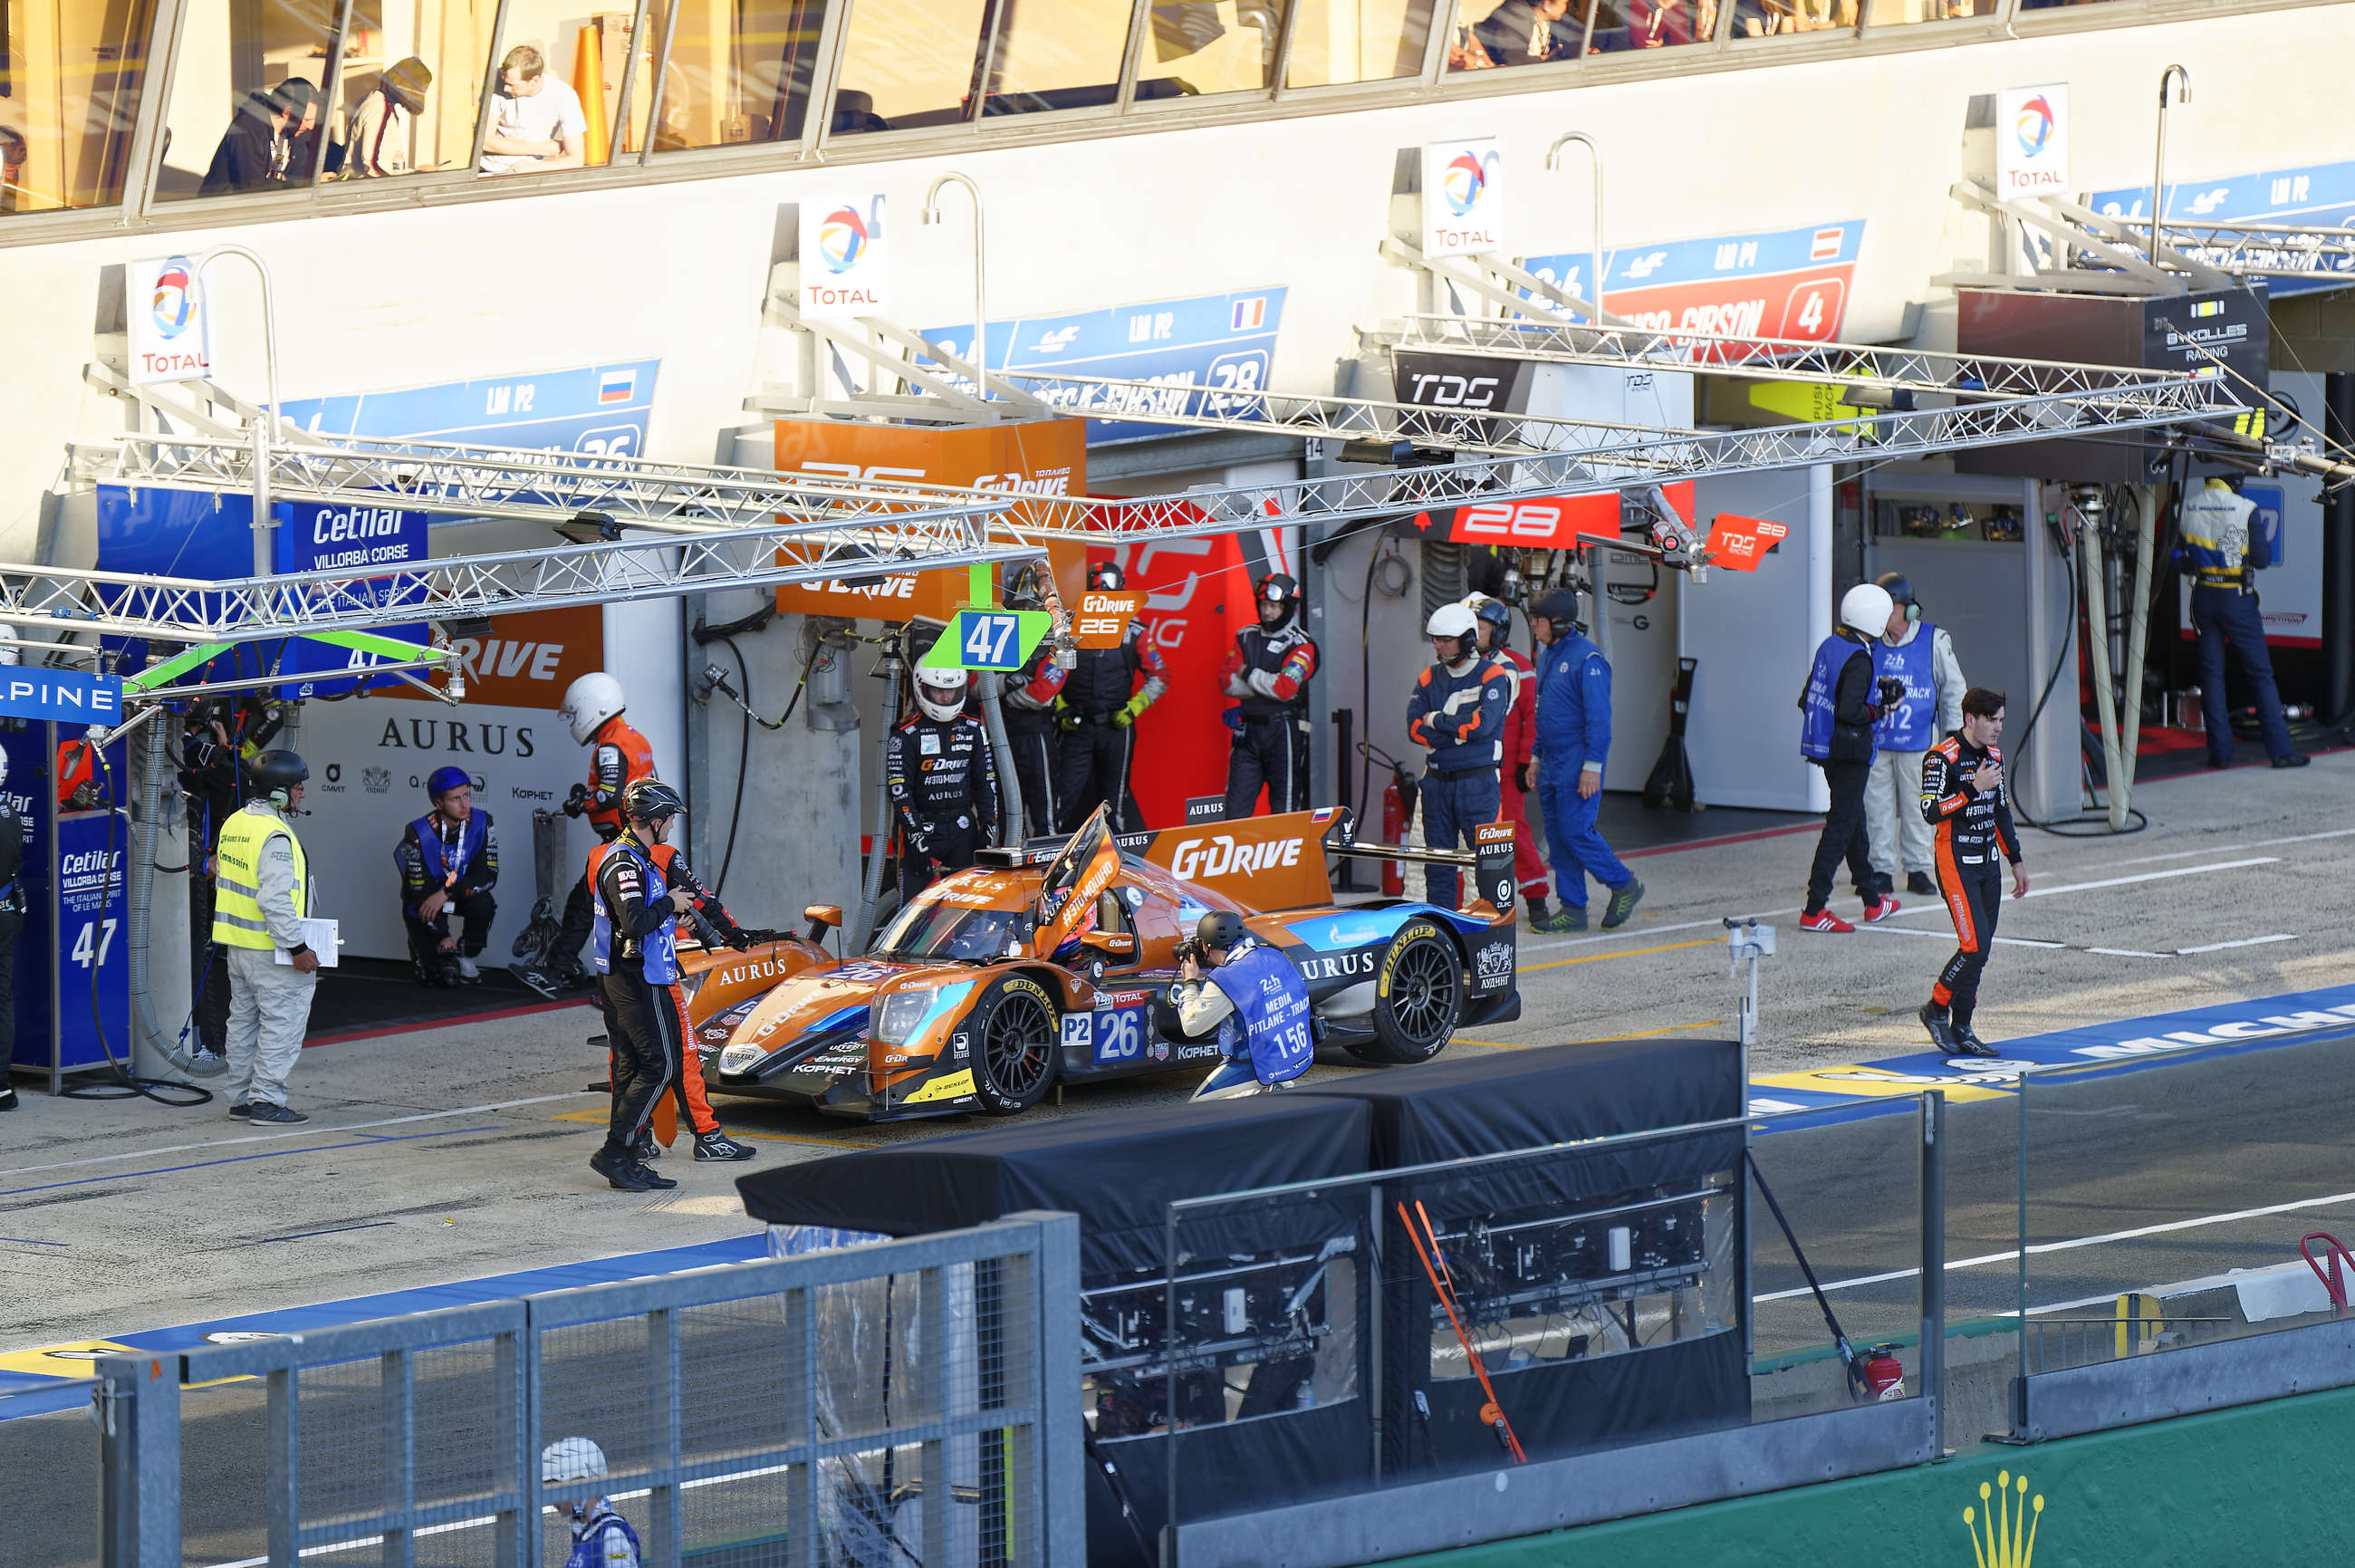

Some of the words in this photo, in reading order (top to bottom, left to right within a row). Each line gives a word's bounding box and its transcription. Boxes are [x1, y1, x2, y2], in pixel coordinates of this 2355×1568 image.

[2008, 169, 2063, 188] TOTAL
[1436, 229, 1495, 247] TOTAL
[808, 286, 878, 304] TOTAL
[1798, 291, 1823, 334] 4
[142, 352, 209, 372] TOTAL
[2185, 345, 2229, 362] RACING
[1207, 361, 1260, 410] 28
[1411, 373, 1500, 407] TDS
[1464, 503, 1562, 537] 28
[1755, 522, 1787, 537] 28
[1721, 532, 1756, 551] TDS
[313, 548, 370, 570] VILLORBA
[370, 544, 409, 563] CORSE
[1079, 618, 1120, 634] 26
[966, 615, 1016, 664] 47
[0, 681, 113, 711] PINE
[1906, 687, 1930, 699] RACK
[377, 717, 534, 757] AURUS
[1189, 803, 1224, 816] AURUS
[1479, 842, 1514, 856] AURUS
[62, 850, 120, 875] Cetilar
[62, 874, 97, 889] VILLORBA
[1044, 885, 1073, 925] AURUS
[71, 918, 118, 968] 47
[1384, 926, 1431, 974] DUNLOP
[719, 957, 786, 986] AURUS
[822, 967, 884, 981] 26
[1299, 951, 1375, 981] URUS
[1016, 980, 1057, 1020] DUNLOP
[1114, 992, 1143, 1003] TOTAL
[1265, 992, 1293, 1015] MEDIA
[1064, 1017, 1089, 1042] P2
[1100, 1010, 1139, 1059] 26
[1248, 1013, 1285, 1036] PITLANE
[1274, 1022, 1308, 1059] 156
[944, 1078, 969, 1090] DUNLOP
